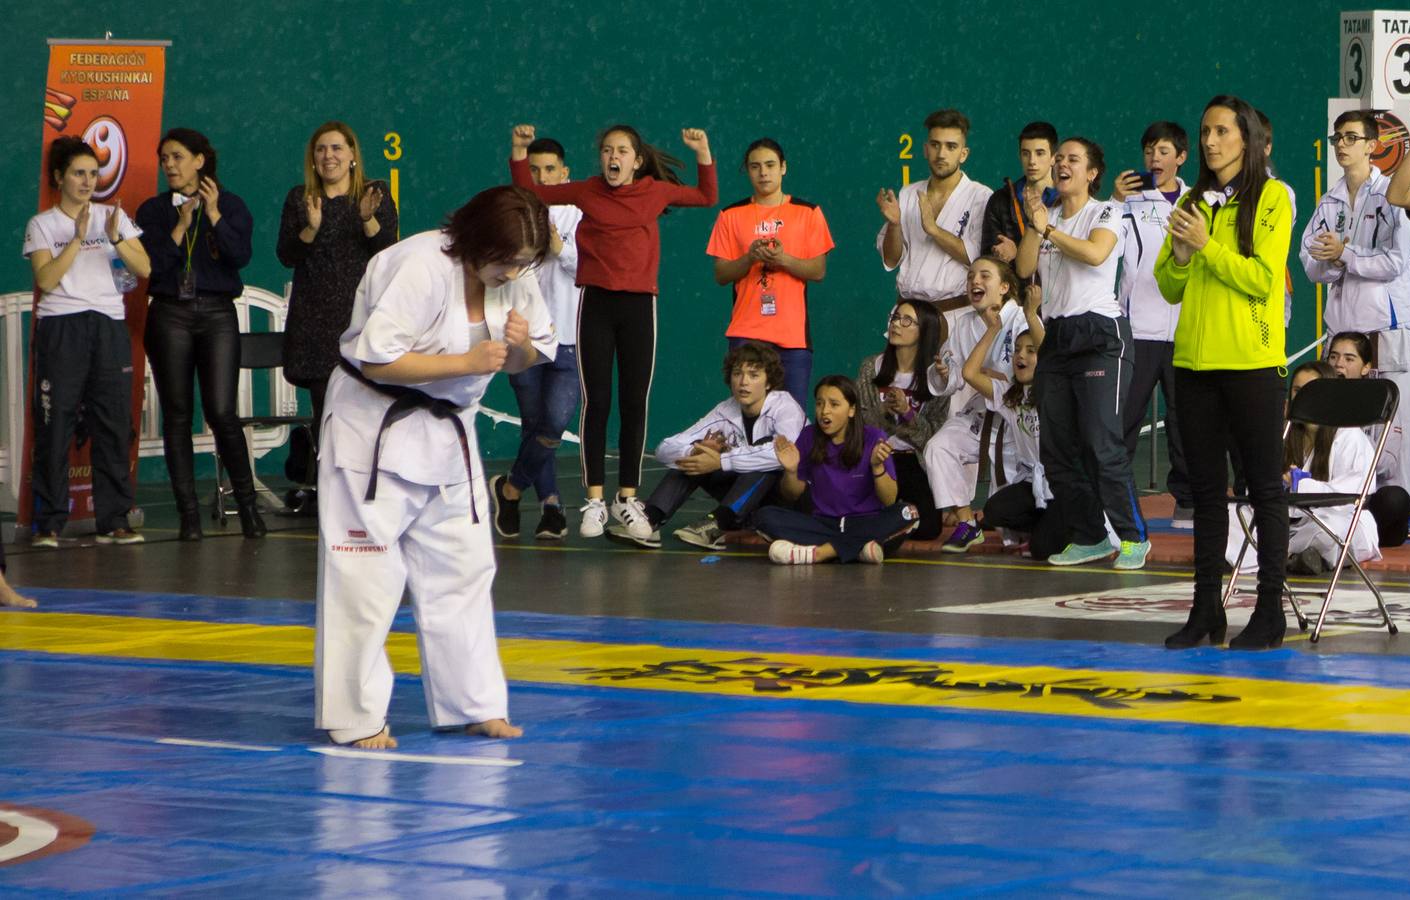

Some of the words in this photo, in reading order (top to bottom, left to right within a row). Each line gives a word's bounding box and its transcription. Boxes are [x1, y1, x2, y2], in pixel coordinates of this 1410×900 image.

[1344, 19, 1371, 34] TATAMI
[69, 50, 146, 66] FEDERACIÓN
[61, 71, 153, 84] KYOKUSHINKAI
[1349, 43, 1363, 94] 3
[82, 87, 130, 101] ESPAÑA
[383, 132, 402, 160] 3
[899, 134, 913, 159] 2
[1313, 139, 1321, 161] 1
